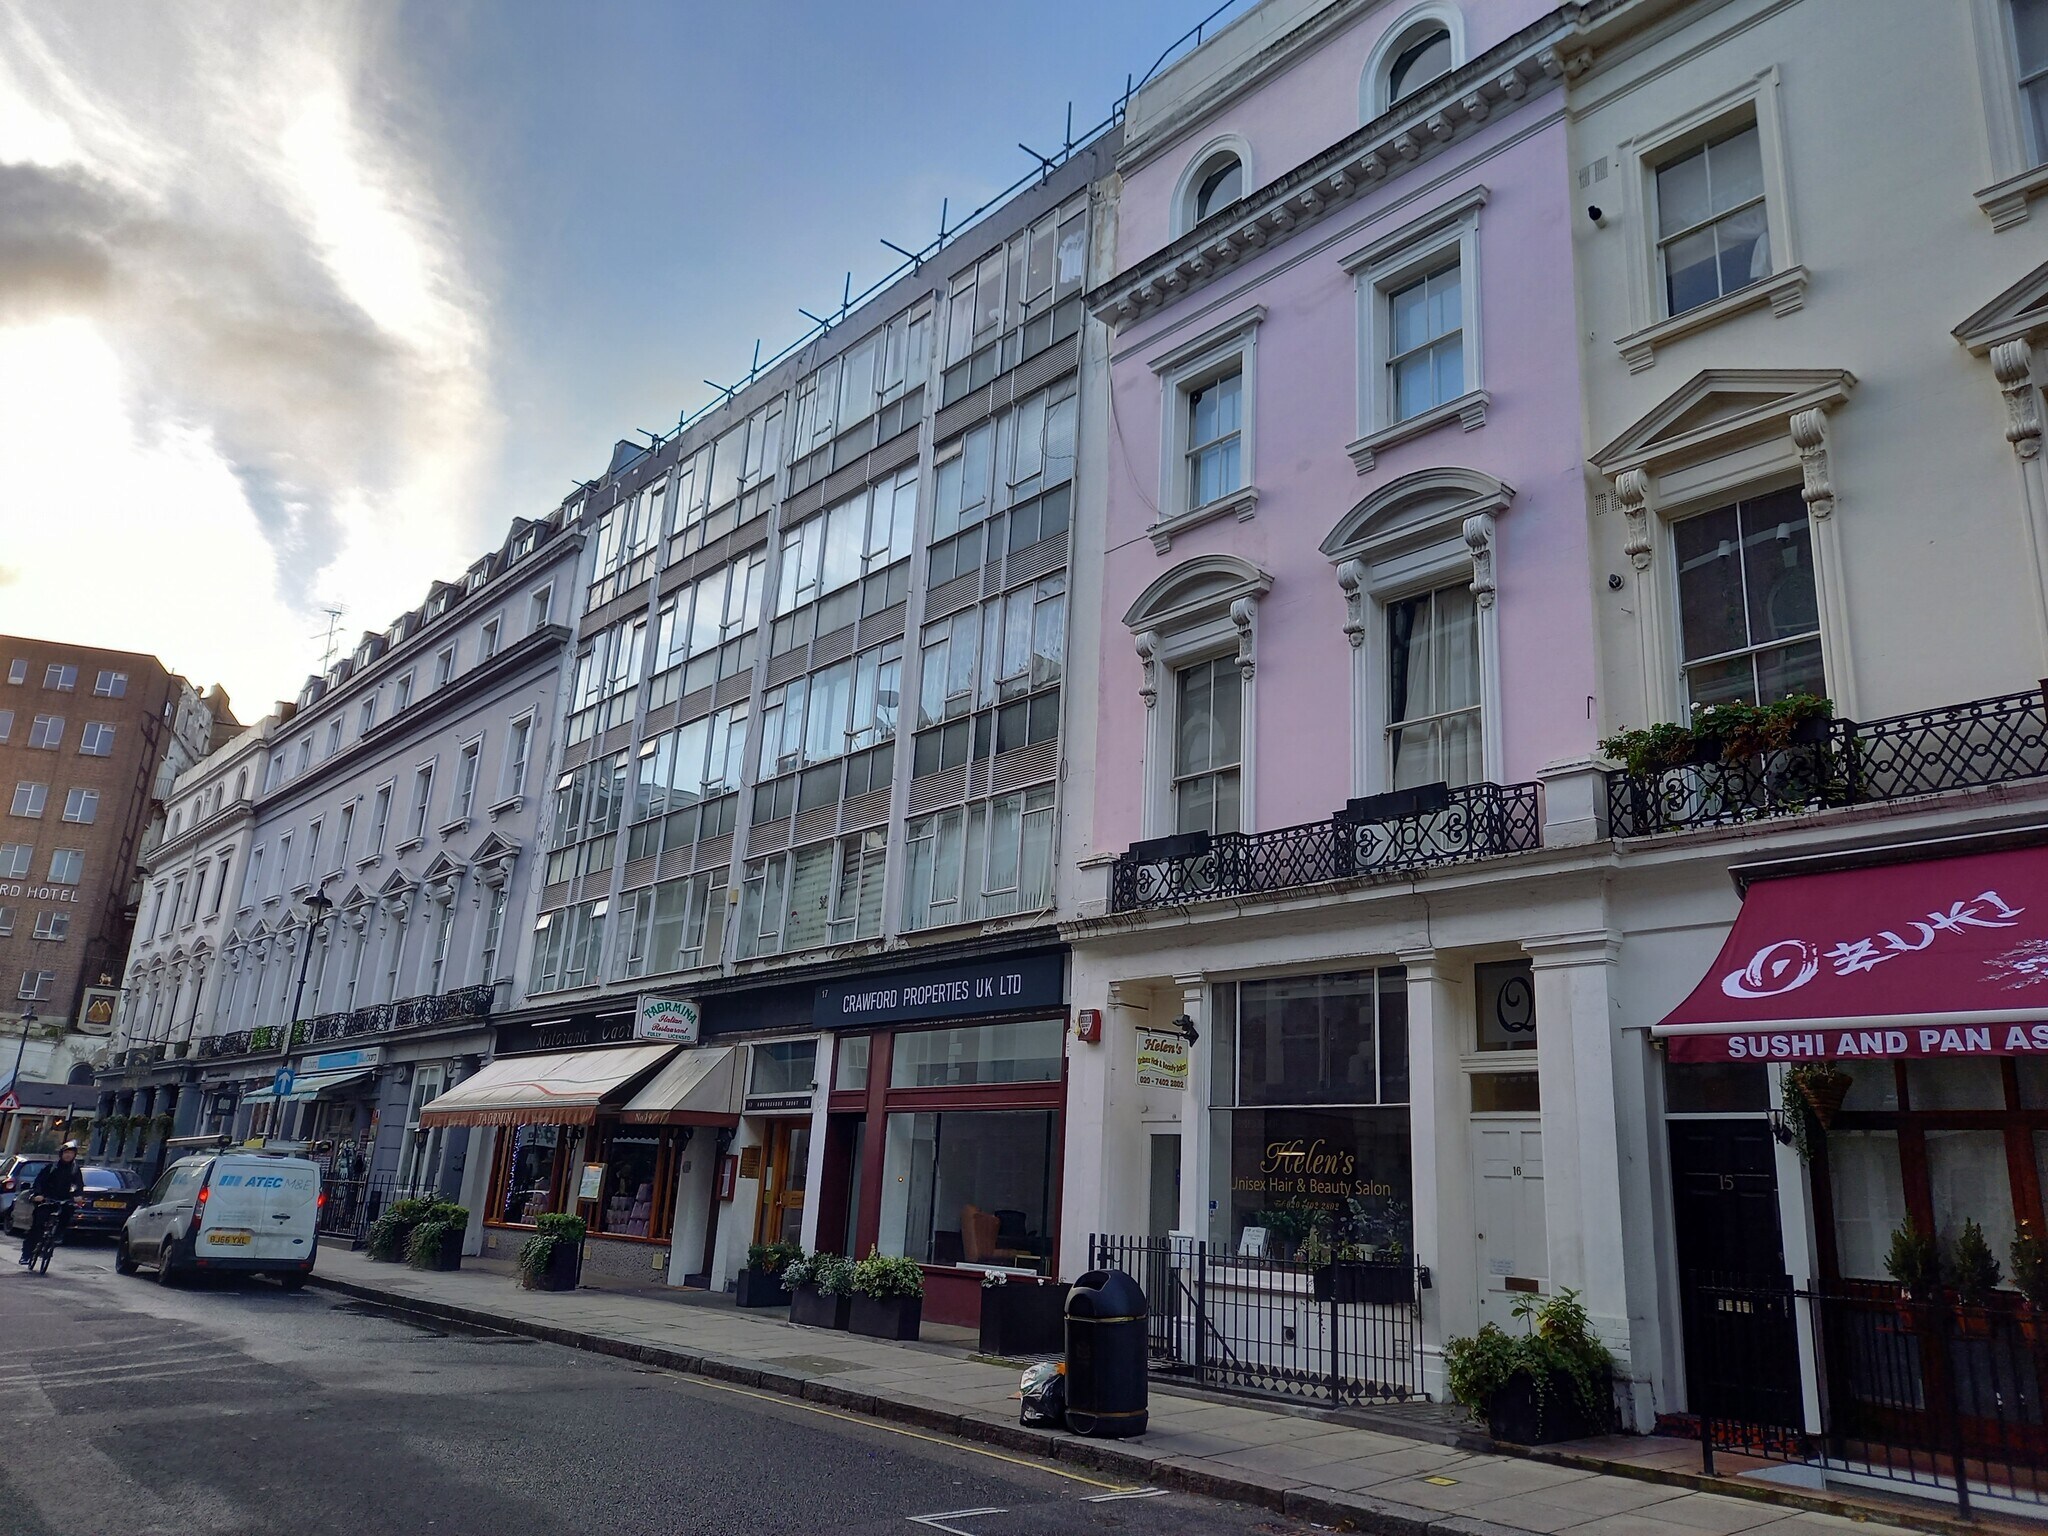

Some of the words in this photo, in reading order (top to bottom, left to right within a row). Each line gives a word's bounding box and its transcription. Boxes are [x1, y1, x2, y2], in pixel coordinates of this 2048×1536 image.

[27, 886, 79, 902] HOTEL
[821, 989, 829, 999] 17
[842, 990, 897, 1013] CRAWFORD
[903, 980, 970, 1007] PROPERTIES
[976, 977, 993, 998] UK
[1000, 973, 1022, 996] LTD
[1497, 976, 1536, 1033] Q
[644, 1002, 698, 1025] TAORMINA
[658, 1015, 683, 1025] Italian
[651, 1023, 688, 1035] Restaurant
[667, 1033, 691, 1041] LICENSED
[1144, 1038, 1183, 1055] Helen's
[1728, 1033, 1825, 1059] SUSHI
[1836, 1031, 1909, 1057] AND
[1919, 1027, 1993, 1054] PAN
[2005, 1025, 2048, 1050] AS
[477, 1111, 518, 1125] TAORMINA
[1260, 1138, 1355, 1175] Helen's
[1513, 1166, 1522, 1176] 16
[245, 1176, 283, 1188] ATEC
[284, 1179, 313, 1191] M&E
[1269, 1177, 1293, 1192] Hair
[1297, 1178, 1306, 1193] &
[1310, 1178, 1351, 1198] Beauty
[1355, 1180, 1391, 1196] Salon
[1720, 1174, 1734, 1190] 15
